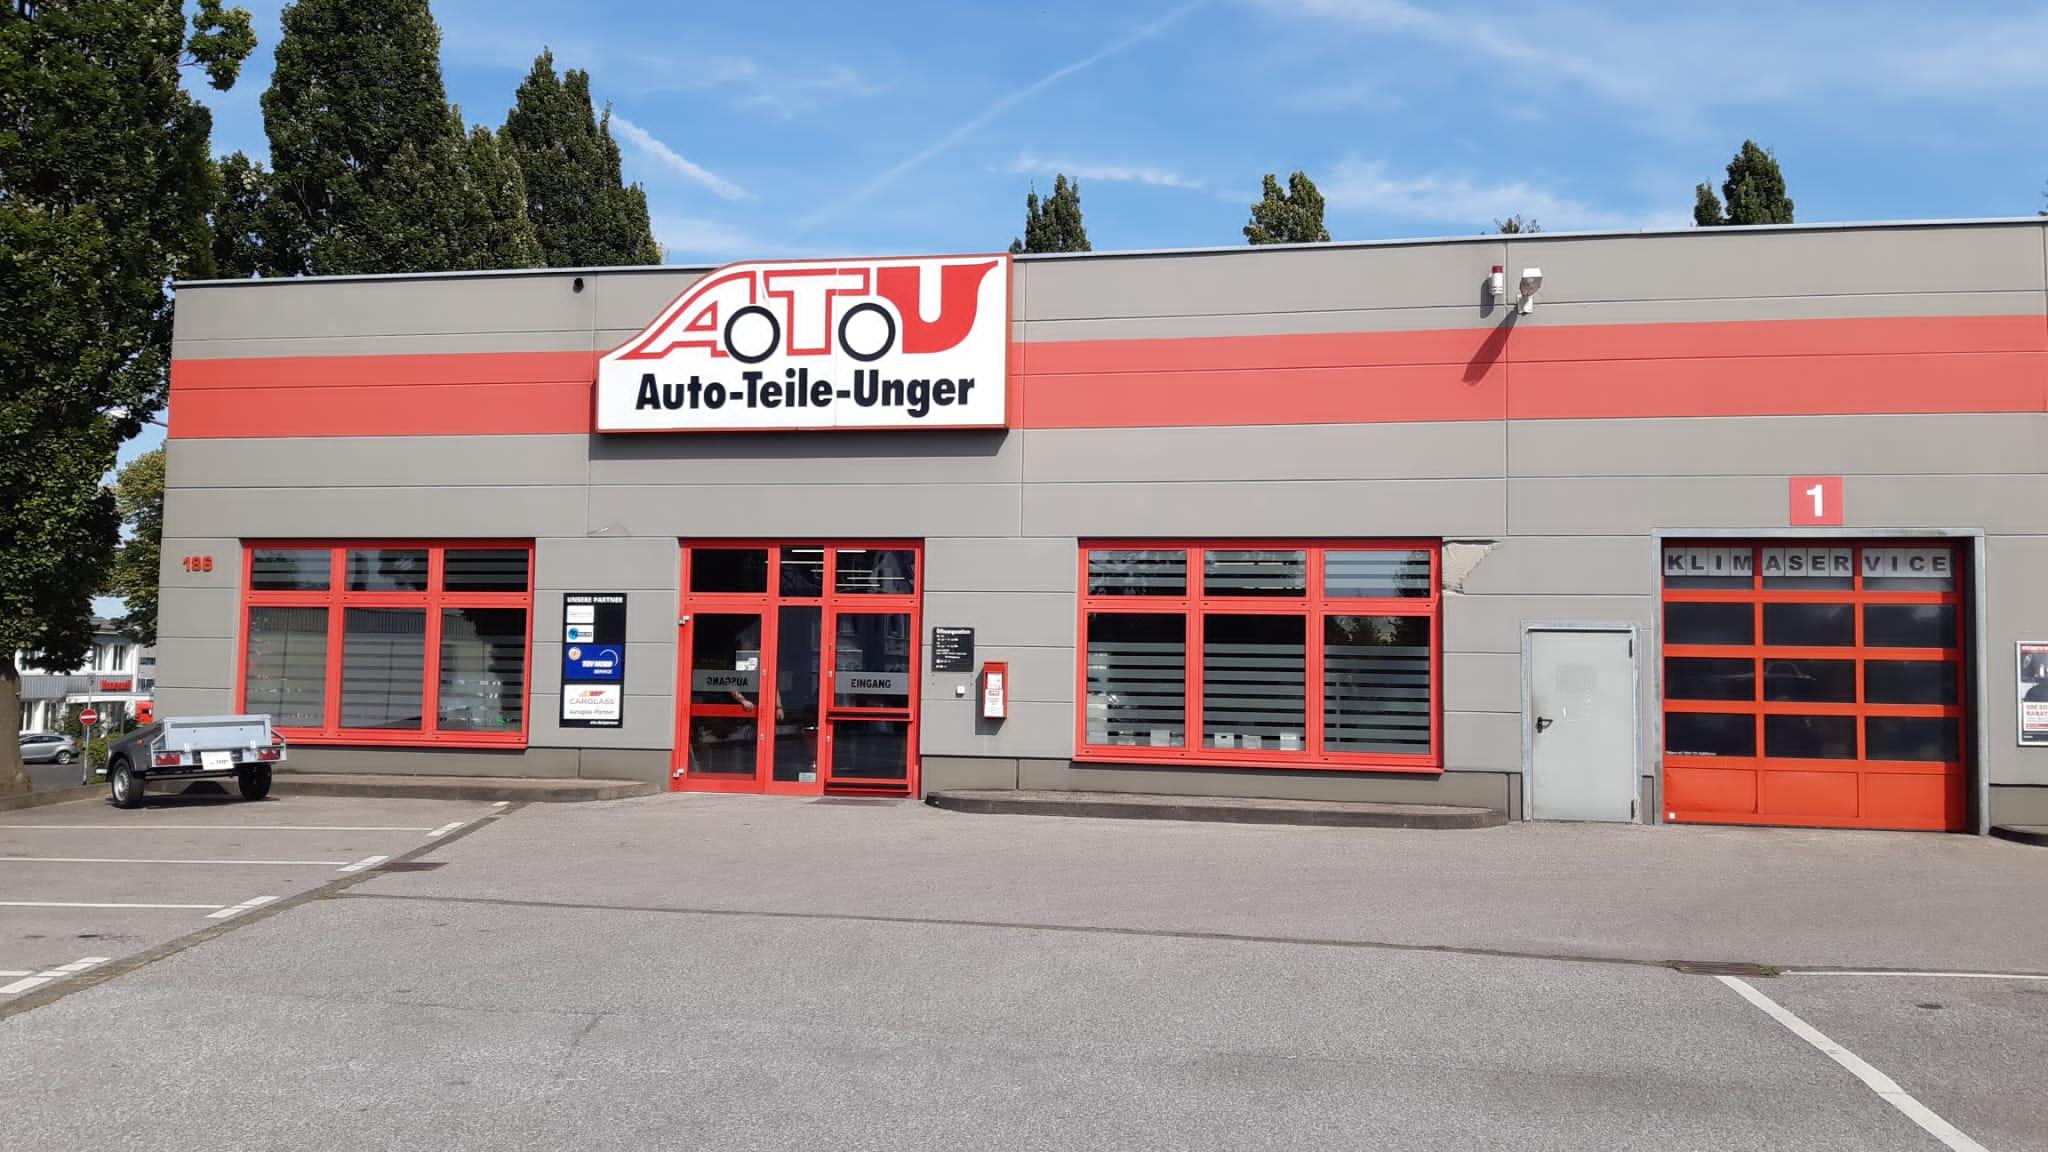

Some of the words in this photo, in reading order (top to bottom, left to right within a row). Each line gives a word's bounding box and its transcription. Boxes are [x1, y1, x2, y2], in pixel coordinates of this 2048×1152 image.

[635, 367, 975, 418] Auto-Teile-Unger
[1806, 484, 1823, 517] 1
[183, 555, 213, 572] 186
[851, 678, 892, 688] EINGANG
